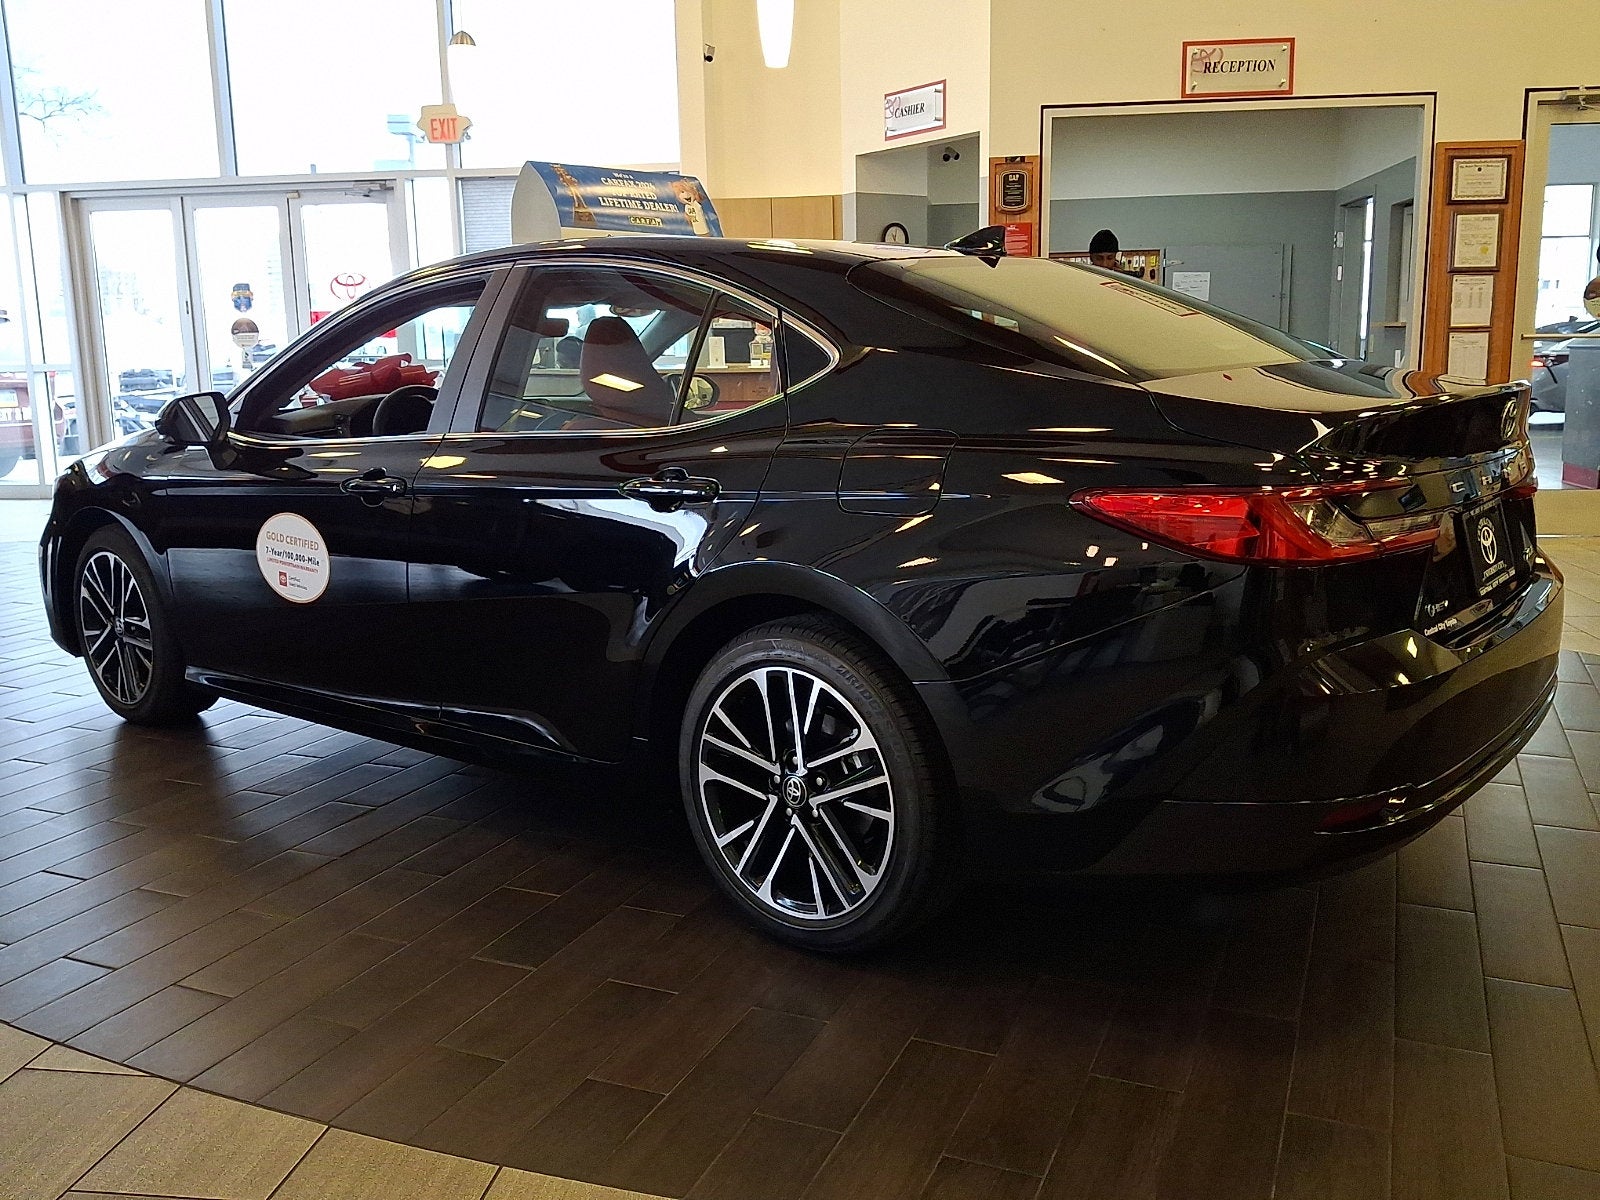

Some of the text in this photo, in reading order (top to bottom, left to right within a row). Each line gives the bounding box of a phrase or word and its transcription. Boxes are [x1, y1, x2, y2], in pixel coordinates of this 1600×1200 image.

[1202, 58, 1277, 75] RECEPTION
[894, 102, 925, 119] CASHIER
[429, 118, 458, 140] EXIT
[600, 177, 635, 188] CARFAX
[598, 196, 679, 213] LIFETIME DEALER!
[266, 530, 319, 551] GOLD CERTIFIED
[265, 546, 320, 566] 7-Year/100,000-Mile
